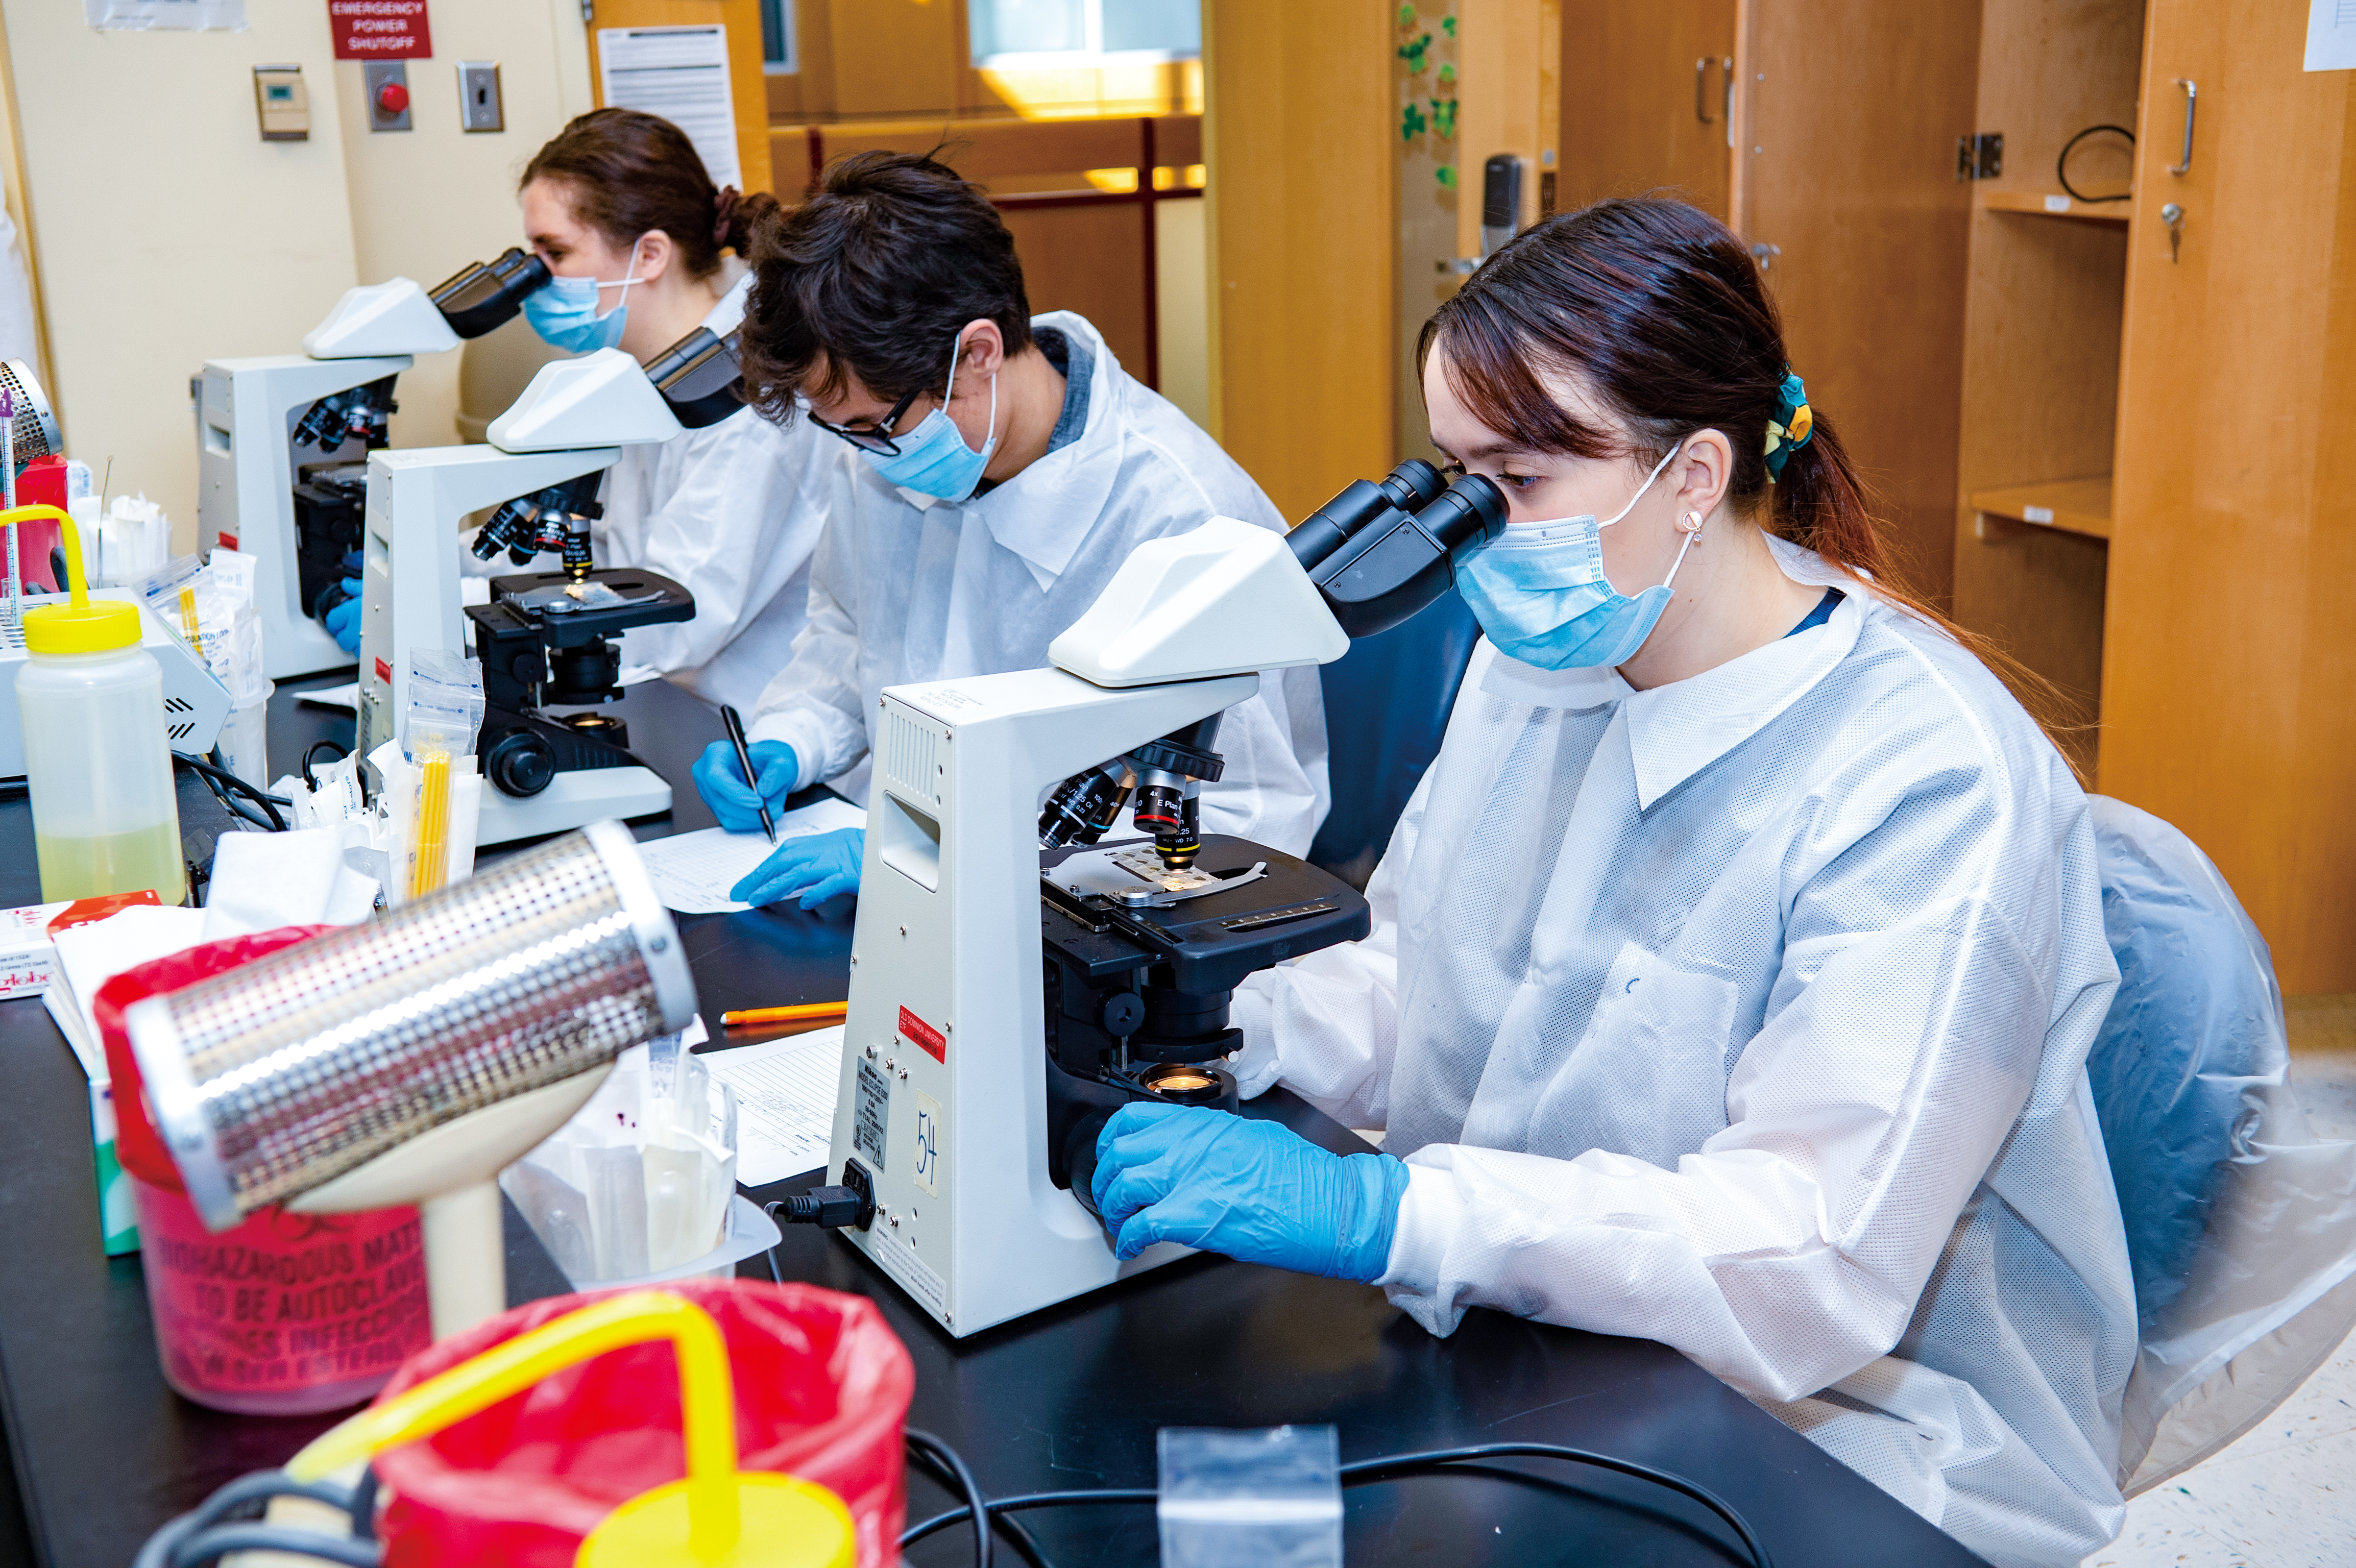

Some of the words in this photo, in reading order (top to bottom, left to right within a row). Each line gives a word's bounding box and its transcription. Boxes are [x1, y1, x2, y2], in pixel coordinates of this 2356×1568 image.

[332, 2, 424, 15] EMERGENCY
[352, 19, 408, 33] POWER
[348, 36, 416, 51] SHUTOFF
[1075, 778, 1089, 791] Plan
[1080, 772, 1093, 782] ikon
[1067, 797, 1075, 805] WD
[1076, 804, 1086, 814] 0.23
[1165, 801, 1178, 810] Plan
[908, 1015, 925, 1035] DOMINION
[925, 1028, 944, 1049] UNIVERSITY
[864, 1064, 877, 1081] Nikon
[859, 1070, 868, 1085] MODEL
[869, 1079, 881, 1095] ECLIPSE
[917, 1110, 937, 1185] 54
[234, 1288, 269, 1324] BE
